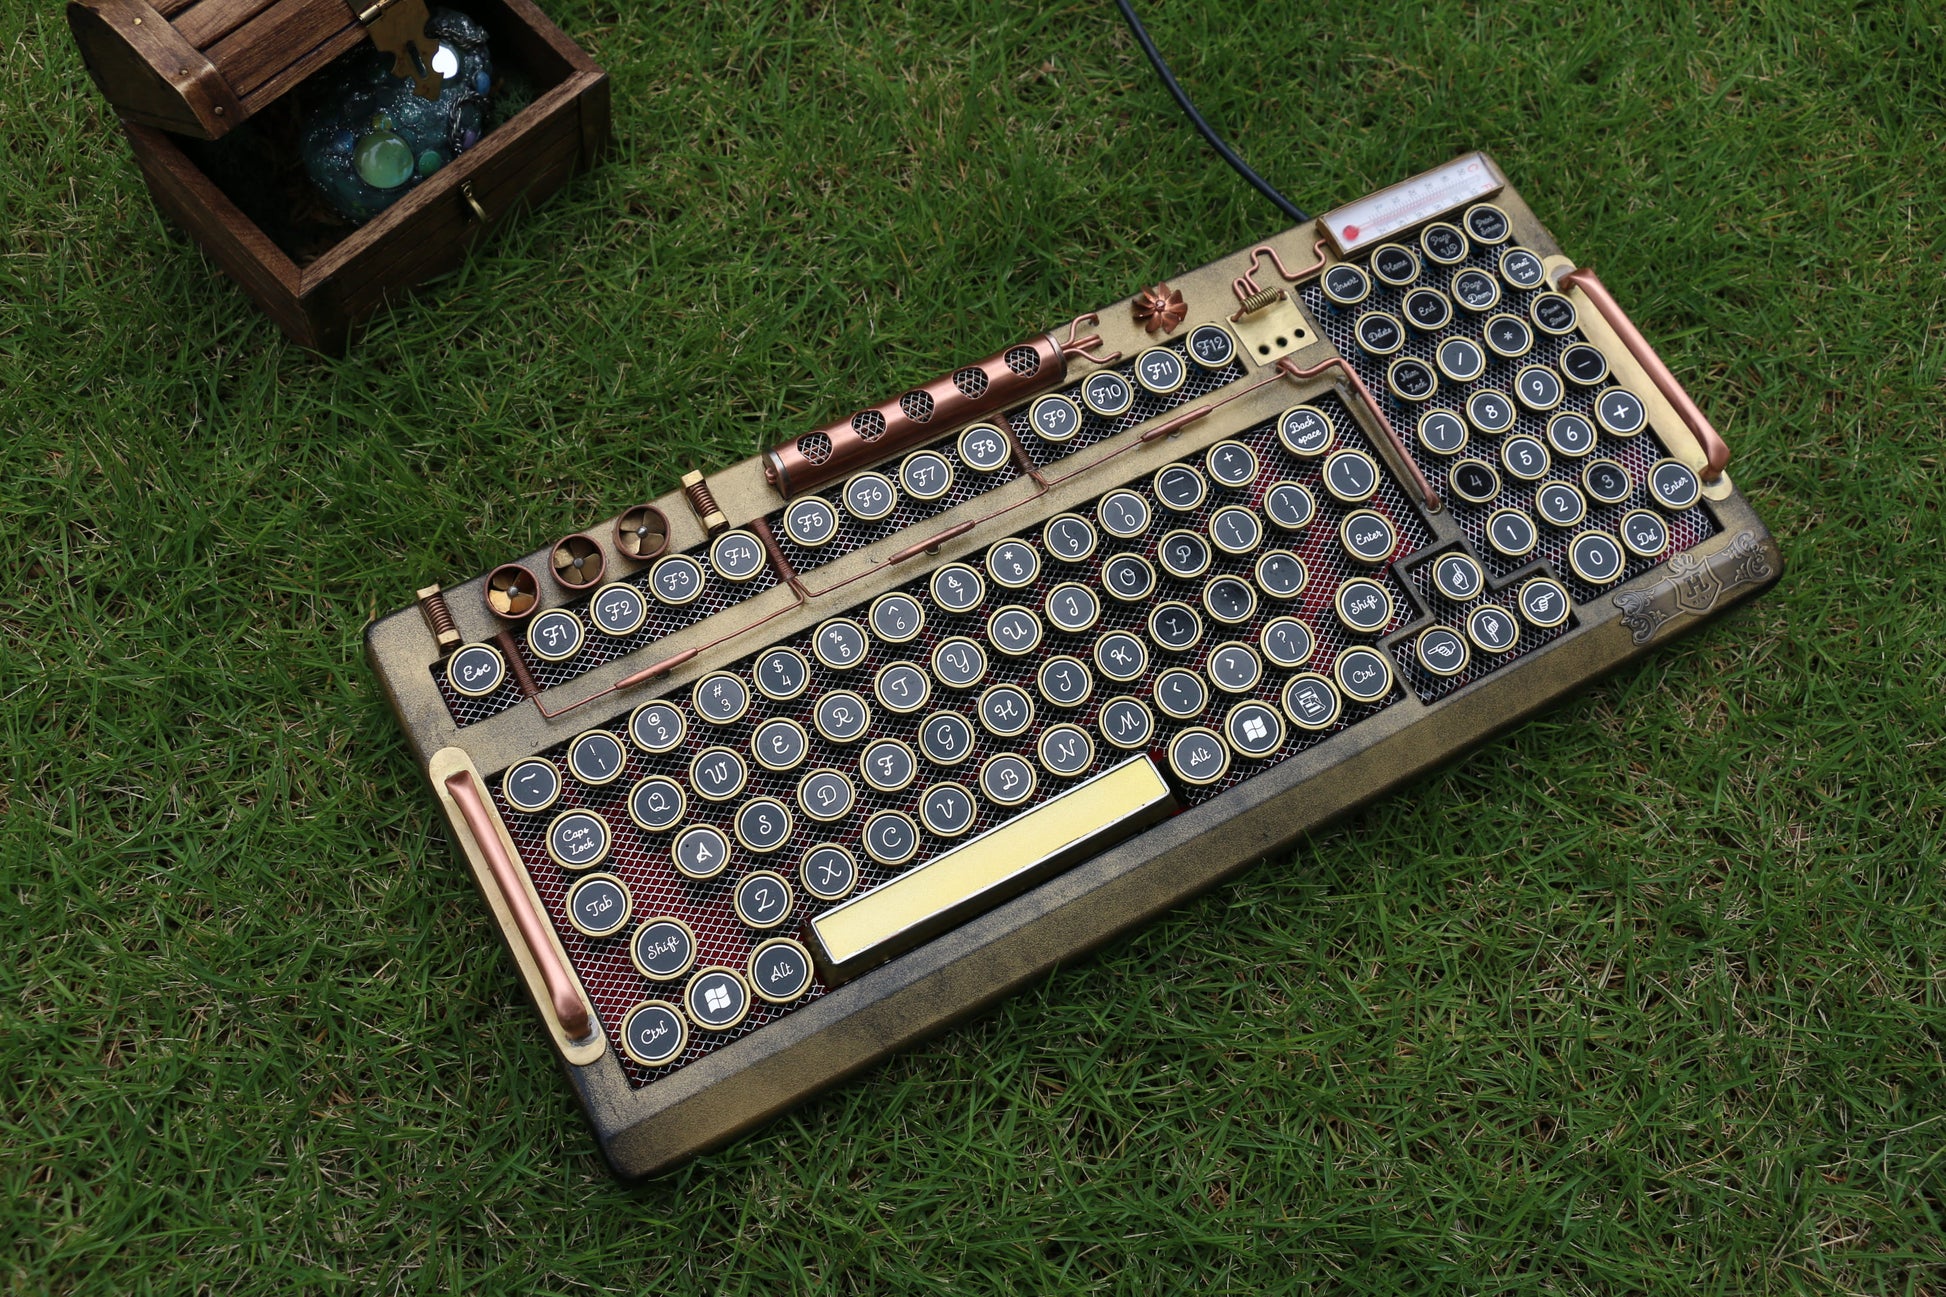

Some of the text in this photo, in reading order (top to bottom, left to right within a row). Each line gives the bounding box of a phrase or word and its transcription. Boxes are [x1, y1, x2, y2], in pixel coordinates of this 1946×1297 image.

[1430, 234, 1451, 246] Page
[1519, 268, 1535, 280] Lock
[1333, 276, 1359, 292] Insert
[1462, 280, 1482, 292] Page
[1467, 290, 1491, 304] Down
[1418, 301, 1436, 316] End
[1368, 328, 1392, 342] Delete
[1196, 336, 1225, 356] F12
[1147, 361, 1172, 380] F11
[1092, 384, 1121, 404] F10
[1407, 378, 1427, 392] Lock
[1532, 380, 1543, 396] 9
[1043, 409, 1066, 428] F9
[1485, 405, 1498, 419] 8
[1613, 405, 1629, 418] +
[1289, 415, 1315, 434] Back
[1435, 424, 1444, 440] 7
[1567, 426, 1578, 441] 6
[1298, 429, 1322, 445] space
[972, 439, 996, 458] F8
[1224, 452, 1233, 462] +
[1520, 450, 1532, 465] 5
[913, 466, 935, 487] F7
[1234, 468, 1243, 476] =
[1470, 475, 1482, 486] 4
[1602, 474, 1614, 489] 3
[1663, 477, 1688, 495] Enter
[857, 487, 882, 507] F6
[1555, 497, 1568, 512] 2
[1114, 502, 1124, 515] )
[797, 512, 823, 533] F5
[1124, 514, 1135, 526] 0
[1062, 525, 1071, 539] (
[1355, 530, 1383, 545] Enter
[1507, 525, 1517, 540] 1
[1637, 528, 1658, 546] Del
[1069, 539, 1078, 552] 9
[1176, 545, 1191, 564] P
[724, 547, 751, 567] F4
[1590, 550, 1603, 565] 0
[1013, 563, 1023, 575] 8
[663, 571, 689, 591] F3
[948, 576, 962, 588] &
[1683, 571, 1710, 599] H
[955, 588, 963, 602] 7
[605, 600, 632, 621] F2
[1350, 595, 1378, 615] Shift
[897, 617, 905, 630] 6
[1002, 621, 1027, 640] U
[543, 624, 567, 646] F1
[829, 630, 843, 644] %
[1277, 630, 1286, 643] ?
[840, 644, 850, 657] 5
[1110, 646, 1132, 665] K
[773, 659, 783, 673] $
[946, 649, 969, 673] Y
[463, 664, 491, 681] Esc
[782, 675, 791, 686] 4
[1353, 664, 1376, 684] Ctrl
[713, 683, 722, 698] #
[891, 677, 908, 696] T
[721, 698, 731, 711] 3
[994, 700, 1018, 720] H
[648, 712, 661, 726] @
[833, 707, 854, 727] R
[1118, 711, 1140, 735] M
[657, 727, 669, 740] 2
[937, 725, 954, 750] G
[772, 735, 789, 754] E
[1058, 738, 1075, 763] N
[598, 758, 606, 770] 1
[877, 755, 893, 776] F
[1190, 747, 1211, 766] Alt
[705, 761, 727, 784] W
[1000, 768, 1019, 790] B
[648, 792, 670, 812] Q
[817, 785, 836, 806] D
[936, 799, 954, 819] V
[759, 815, 772, 834] S
[563, 828, 589, 842] Caps
[882, 826, 902, 848] C
[569, 837, 595, 855] Lock
[696, 842, 713, 863] A
[818, 859, 842, 885] X
[586, 894, 612, 916] Tab
[755, 889, 775, 912] Z
[648, 936, 679, 960] Shift
[771, 962, 794, 982] Alt
[641, 1020, 668, 1044] Ctrl
